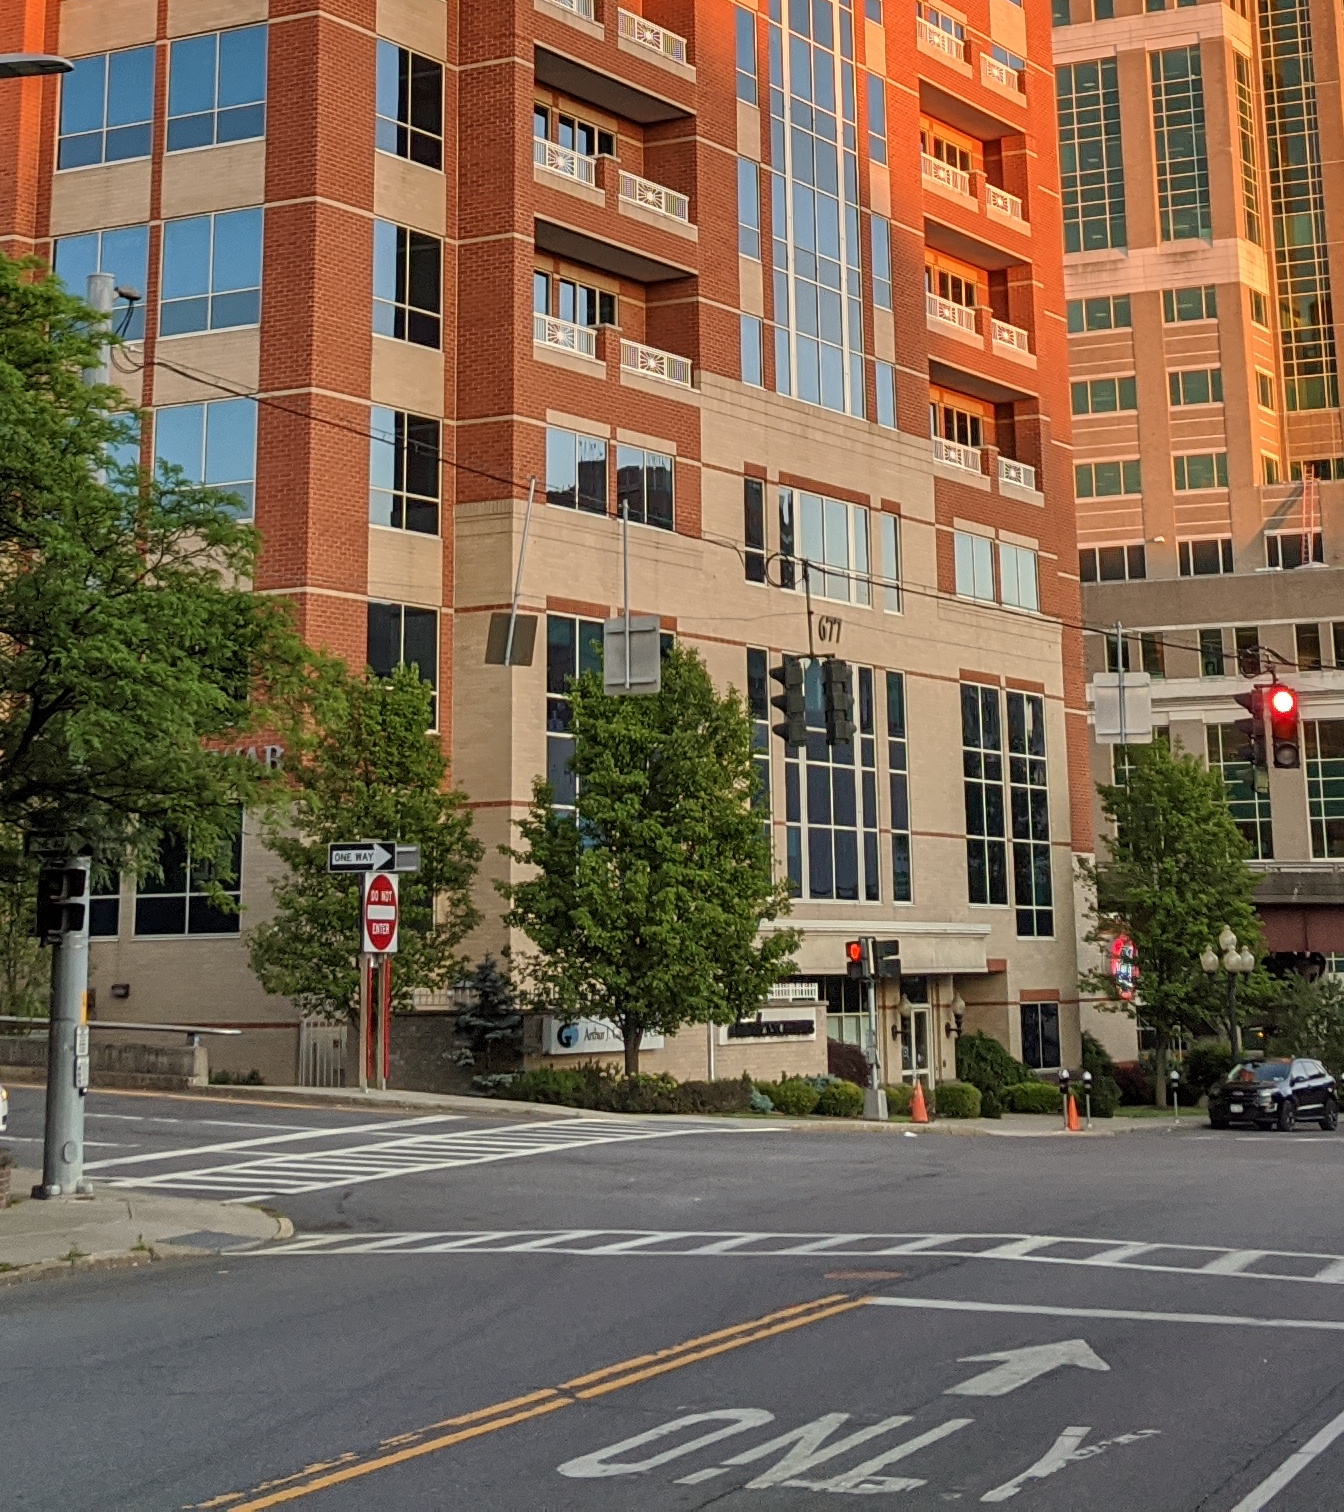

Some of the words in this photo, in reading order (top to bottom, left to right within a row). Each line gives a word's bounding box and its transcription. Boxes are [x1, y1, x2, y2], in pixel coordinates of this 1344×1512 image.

[818, 615, 842, 643] 677
[334, 852, 352, 862] ONE
[356, 852, 374, 862] WAY
[370, 890, 379, 902] DO
[381, 890, 393, 902] NOT
[558, 1408, 1161, 1502] ONLY
